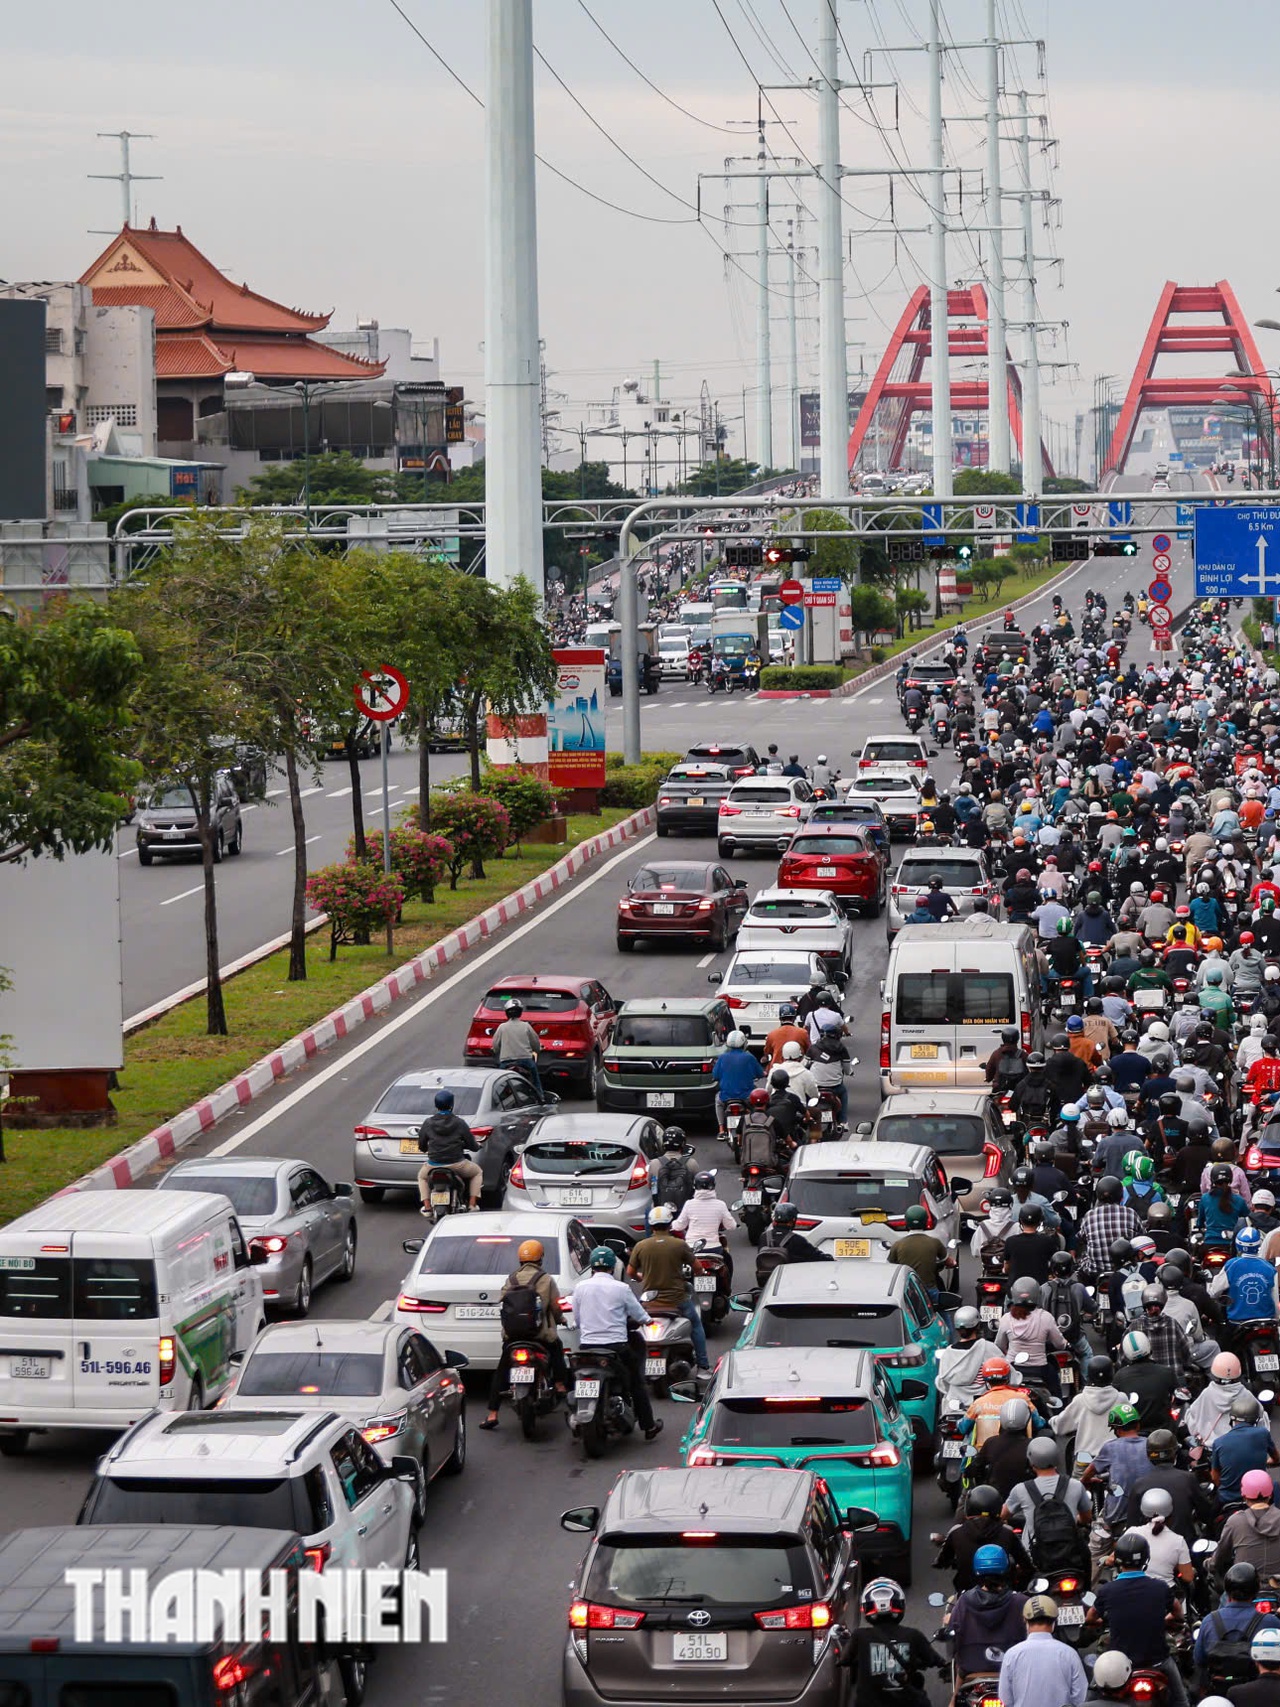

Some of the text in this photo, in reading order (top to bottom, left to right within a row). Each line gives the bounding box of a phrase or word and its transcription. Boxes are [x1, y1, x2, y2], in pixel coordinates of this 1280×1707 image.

[1253, 509, 1267, 520] THỦ
[1248, 523, 1274, 531] 6.5 Km
[1200, 572, 1233, 584] BÌNH LỢI
[1205, 586, 1218, 594] 500
[22, 1358, 39, 1367] 51L
[81, 1361, 151, 1374] 51L-596.46
[15, 1367, 47, 1376] 596.46
[688, 1635, 712, 1647] 51L
[679, 1647, 721, 1659] 430.90
